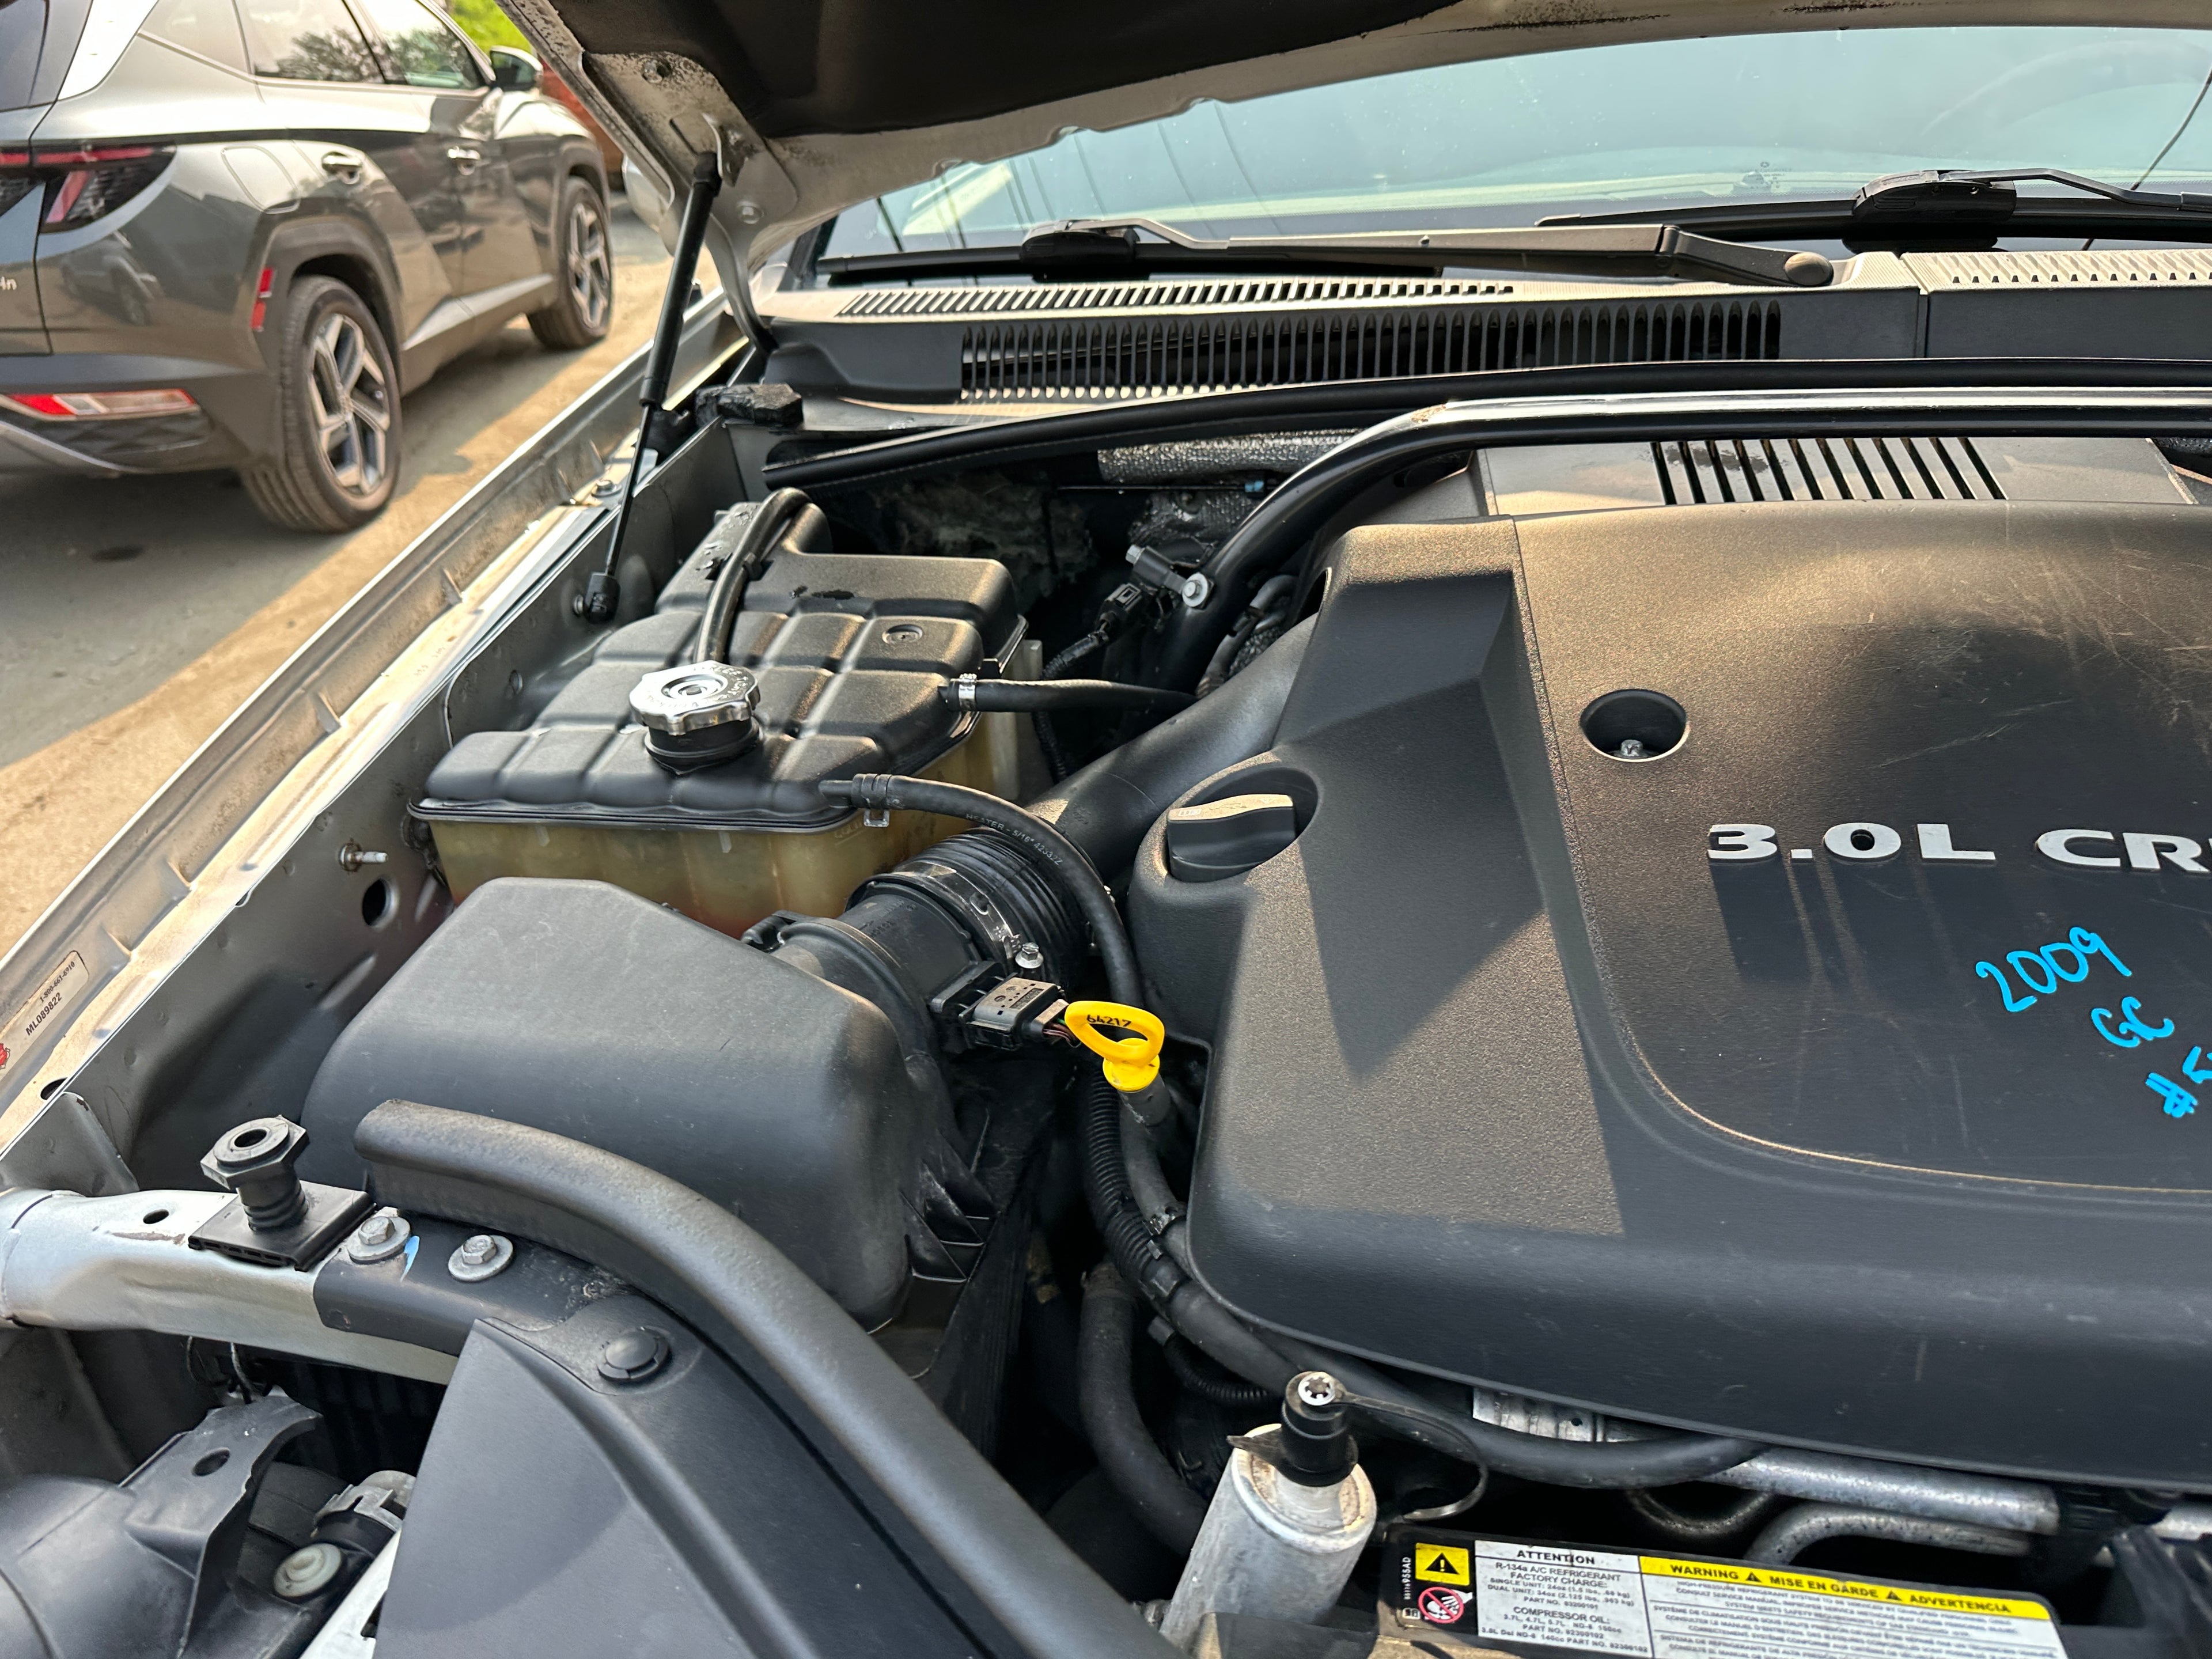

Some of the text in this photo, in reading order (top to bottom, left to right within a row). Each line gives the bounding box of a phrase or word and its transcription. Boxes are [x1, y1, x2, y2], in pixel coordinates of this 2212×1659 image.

[1707, 822, 2212, 872] 3.0L CR
[1975, 926, 2133, 1013] 2009
[39, 960, 75, 1003] 1-800-661-6910
[25, 992, 62, 1036] ML089822
[1086, 1013, 1132, 1028] 64217
[1517, 1550, 1595, 1565] ATTENTION
[1496, 1562, 1621, 1582] R-134a A/C REFRIGERANT
[1510, 1571, 1608, 1588] FACTORY CHARGE:
[1670, 1564, 1739, 1580] WARNING
[1487, 1584, 1510, 1592] DUAL
[1490, 1577, 1520, 1586] SINGLE
[1770, 1575, 1879, 1598] MISE EN GARDE
[1524, 1596, 1544, 1604] PART
[1910, 1594, 2012, 1613] ADVERTENCIA
[1514, 1606, 1611, 1624] COMPRESSOR OIL:
[1522, 1623, 1545, 1632] PART
[1567, 1637, 1589, 1645] PART
